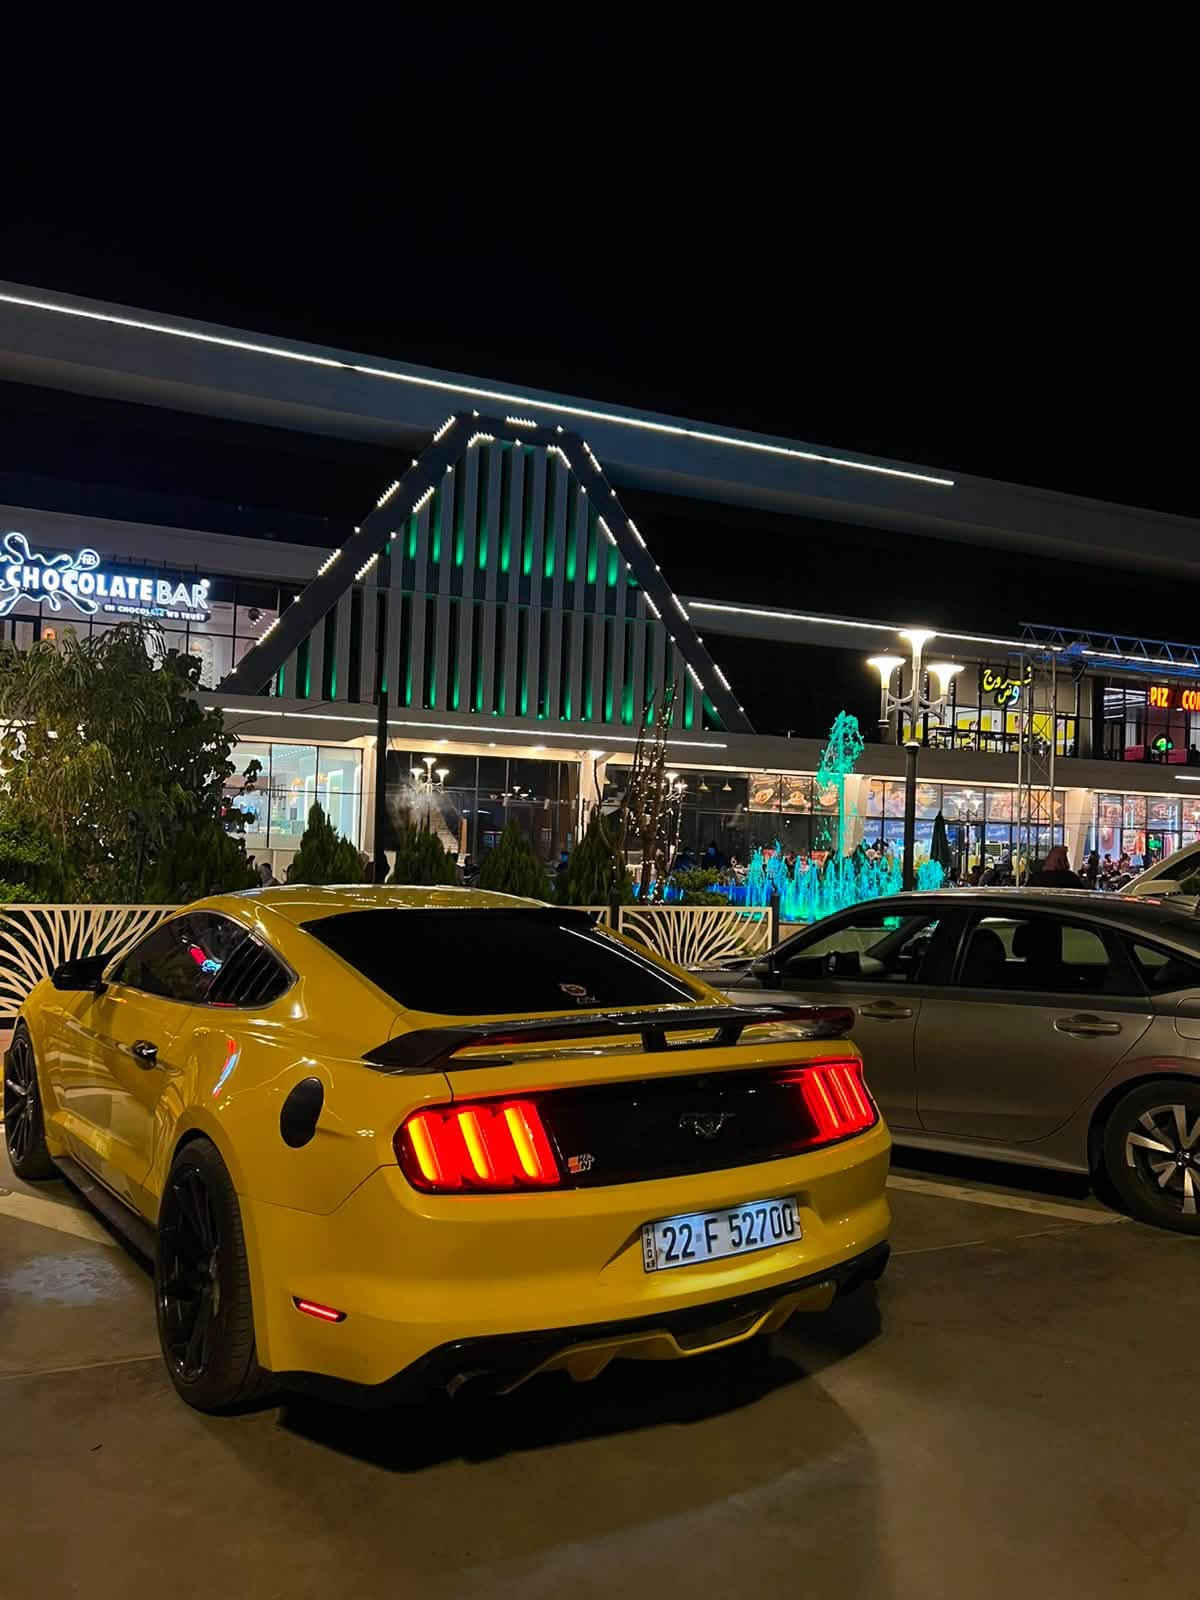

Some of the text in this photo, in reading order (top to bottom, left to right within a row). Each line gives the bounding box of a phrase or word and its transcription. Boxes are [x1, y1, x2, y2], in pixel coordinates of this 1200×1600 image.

[6, 564, 209, 609] CHOCOLATE BAR
[662, 1203, 794, 1261] 22 F 52700
